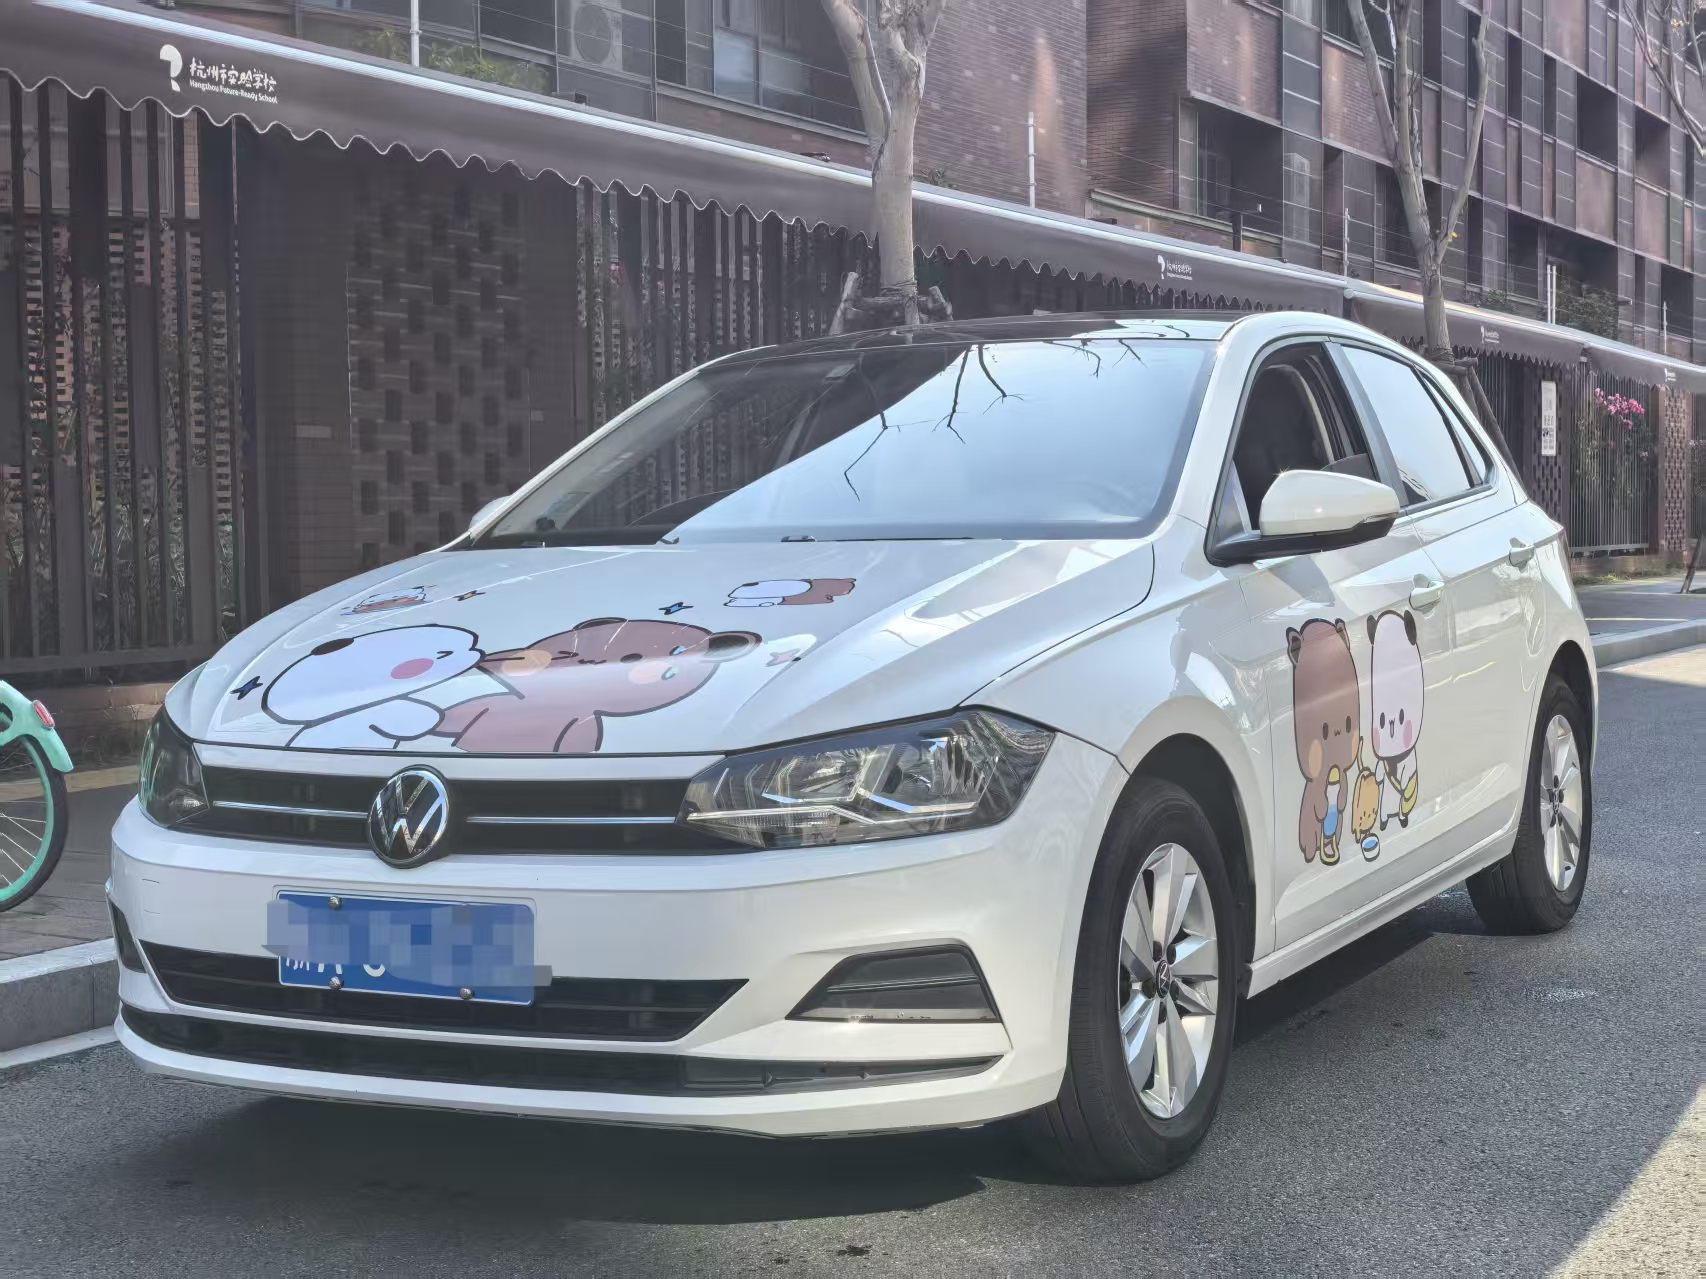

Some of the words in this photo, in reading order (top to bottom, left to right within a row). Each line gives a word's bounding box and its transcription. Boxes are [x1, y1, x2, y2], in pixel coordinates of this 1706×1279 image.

[189, 56, 277, 92] 杭州市实验学校
[189, 79, 219, 93] Hangzhou
[258, 92, 278, 104] School
